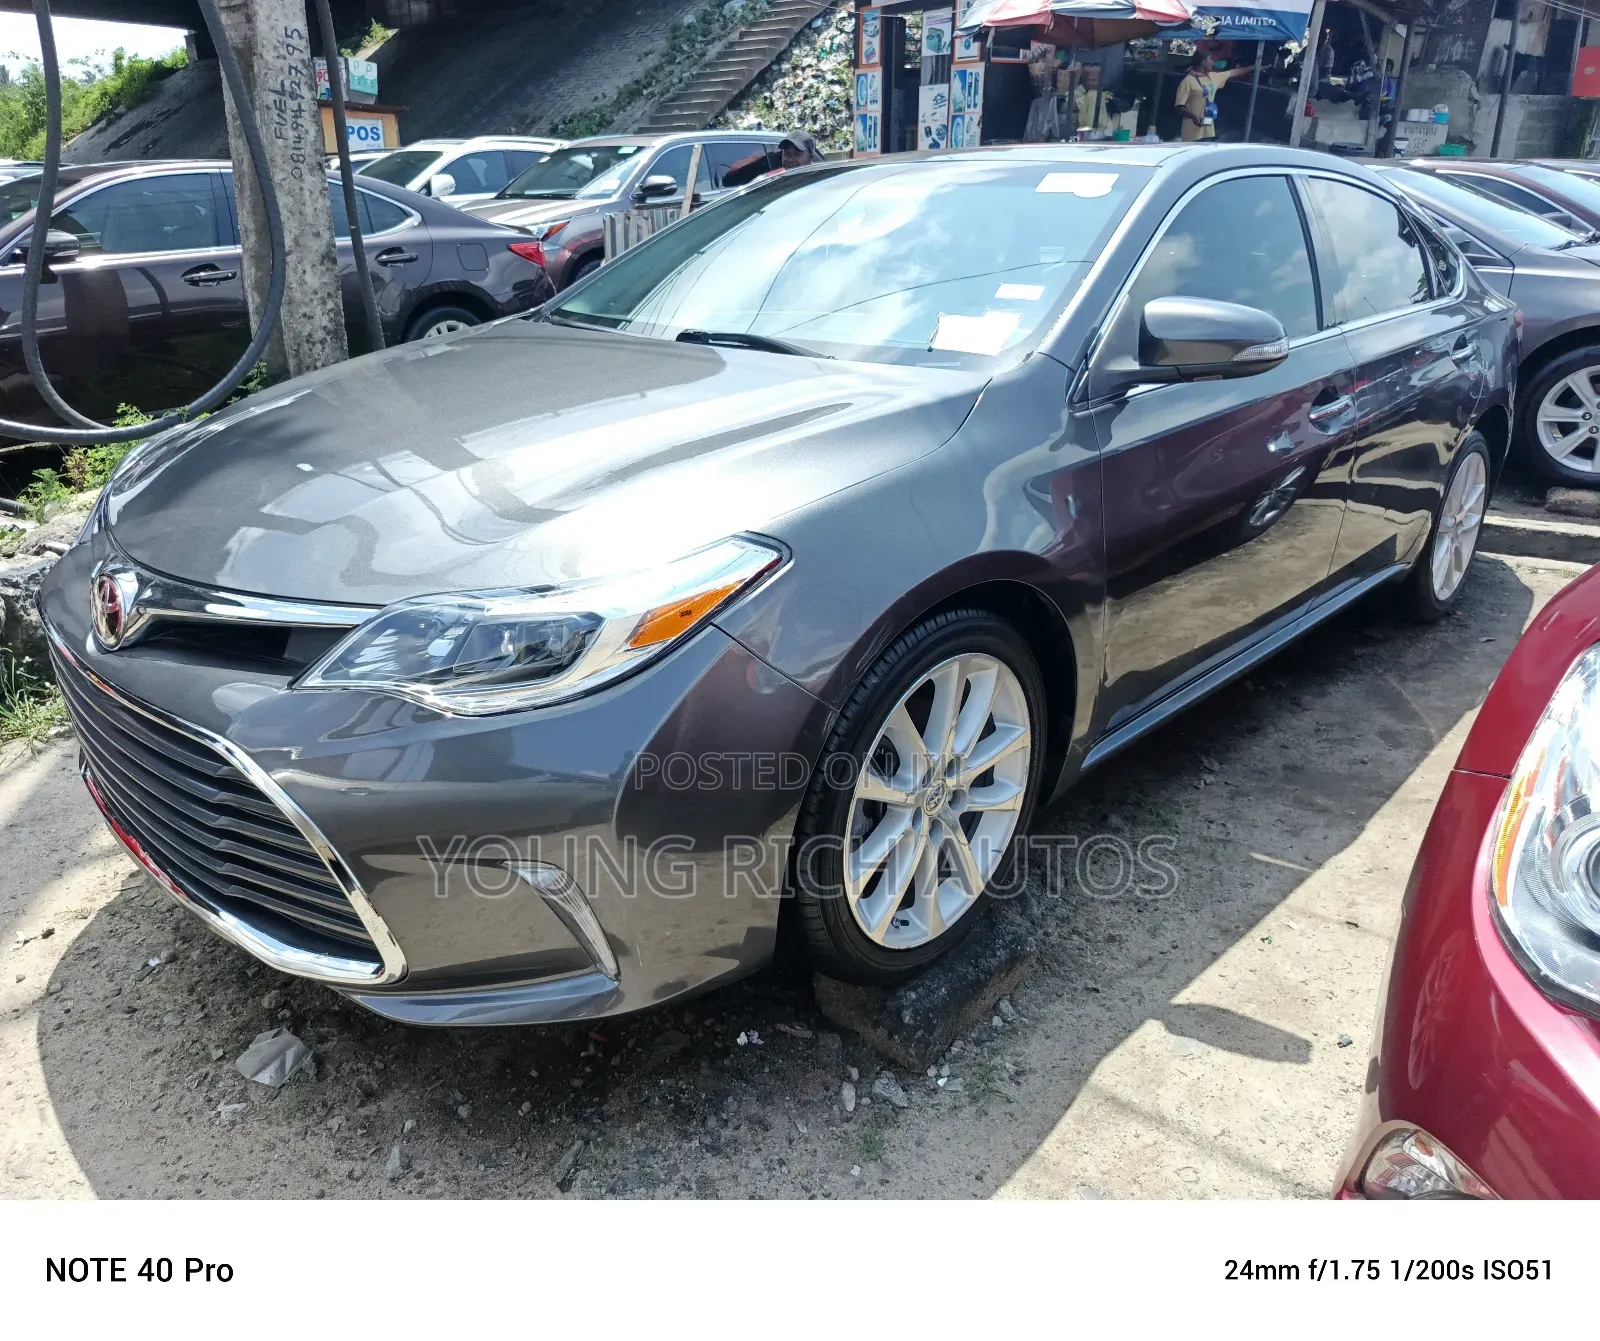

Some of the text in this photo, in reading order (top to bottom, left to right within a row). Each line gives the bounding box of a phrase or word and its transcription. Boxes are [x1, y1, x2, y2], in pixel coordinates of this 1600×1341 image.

[1235, 15, 1277, 26] LIMITED
[268, 79, 288, 141] FUEL
[345, 125, 381, 141] POS
